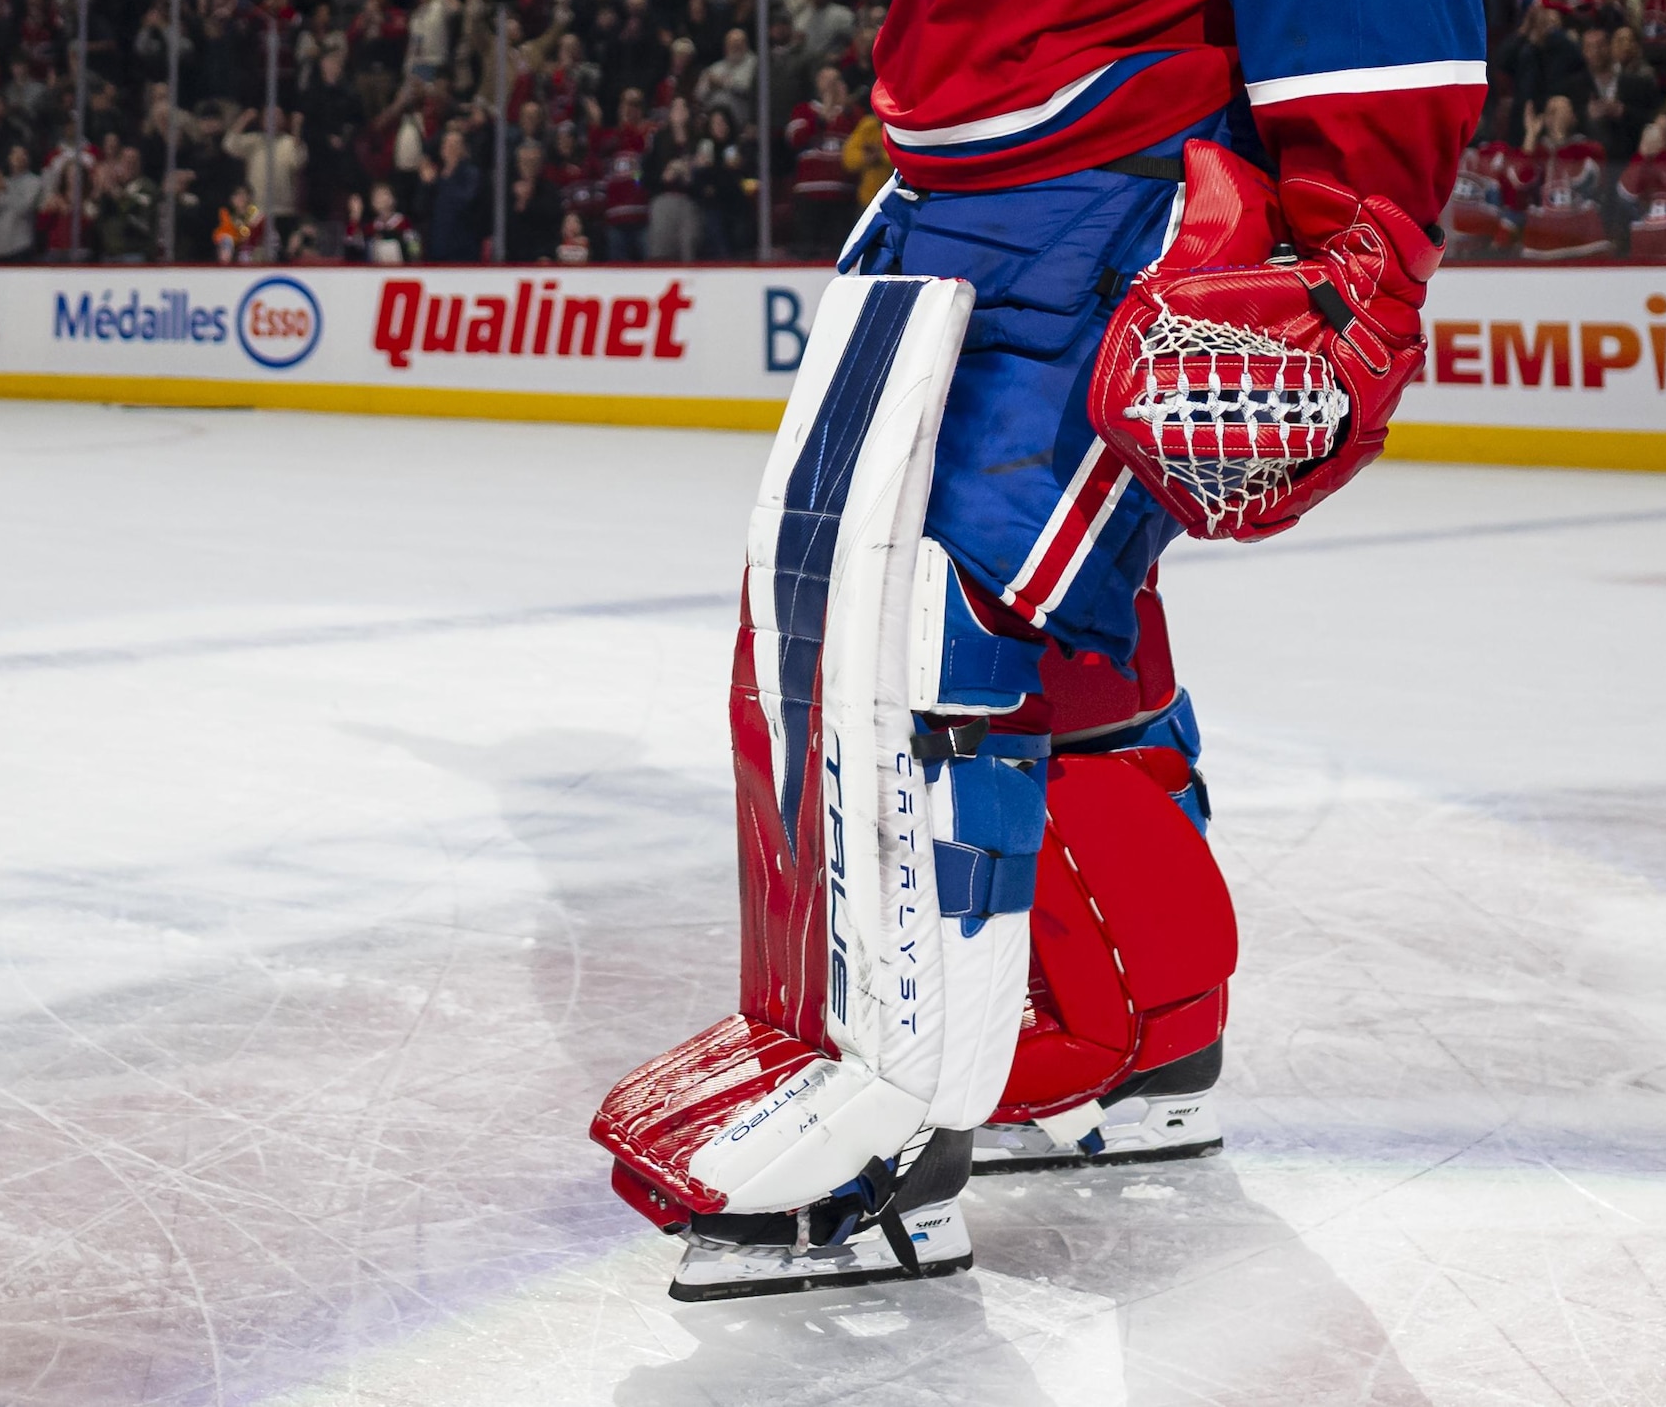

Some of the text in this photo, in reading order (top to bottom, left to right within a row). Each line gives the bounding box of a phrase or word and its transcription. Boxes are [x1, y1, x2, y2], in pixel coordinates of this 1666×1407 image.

[53, 290, 309, 344] Médailles Esso
[372, 278, 694, 370] Qualinet
[823, 731, 849, 1026] TRUE
[895, 752, 918, 1036] CATALYST
